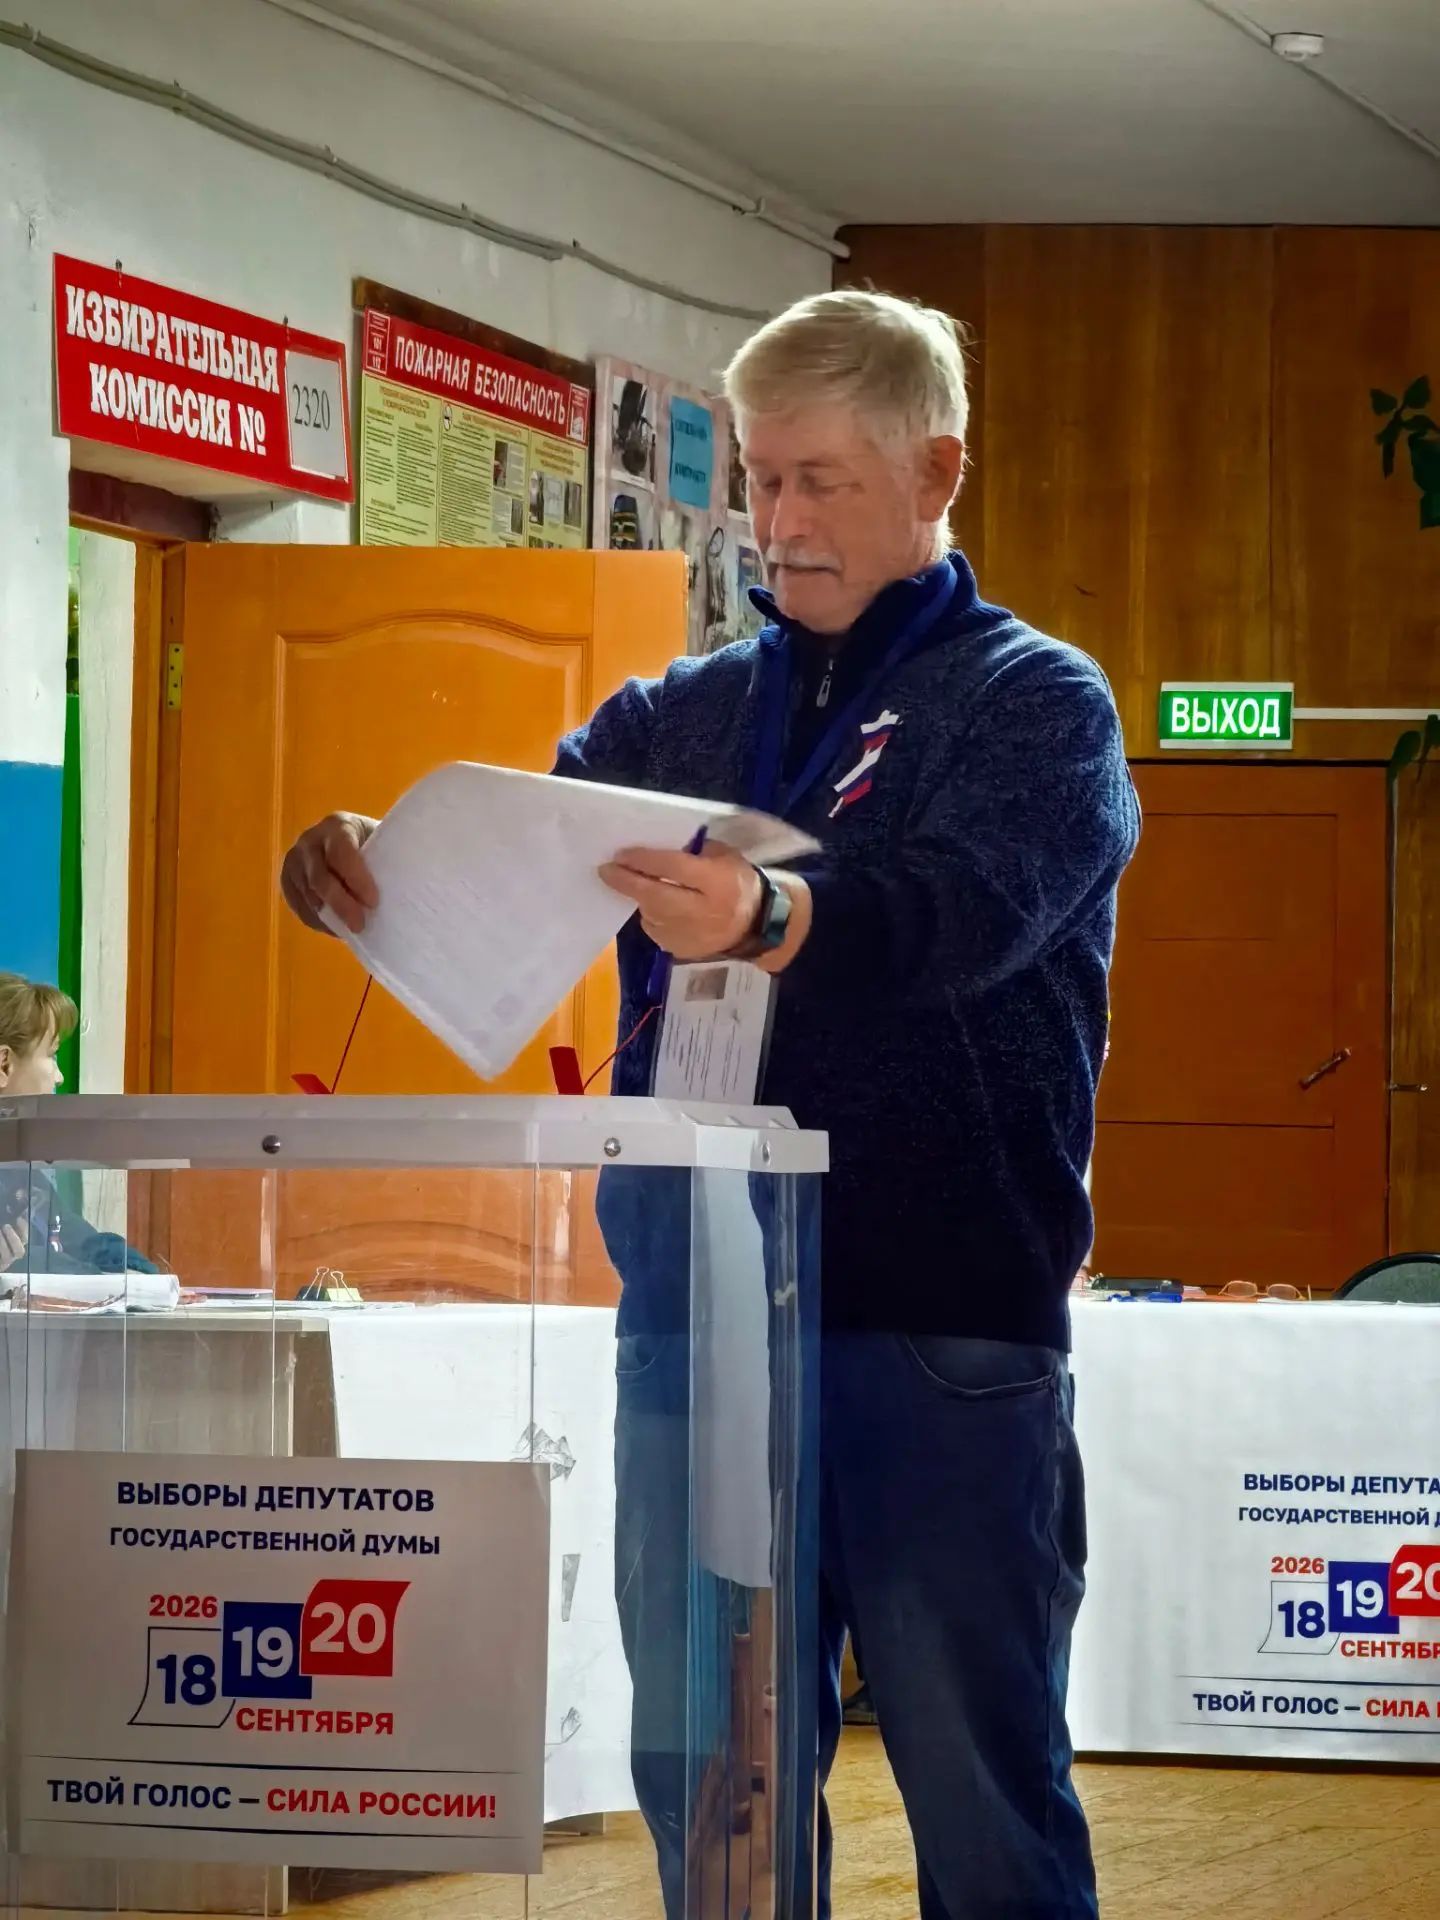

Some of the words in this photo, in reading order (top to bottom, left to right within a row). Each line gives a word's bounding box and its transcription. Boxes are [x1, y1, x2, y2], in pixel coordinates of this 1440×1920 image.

[65, 284, 281, 395] ИЗБИРАТЕЛЬНАЯ
[395, 335, 471, 392] ПОЖАРНАЯ
[474, 363, 566, 425] БЕЗОПАСНОСТЬ
[88, 362, 233, 448] КОМИССИЯ
[238, 403, 267, 456] №
[291, 384, 331, 431] 2320
[1171, 697, 1281, 737] ВЫХОД
[117, 1481, 247, 1508] ВЫБОРЫ
[255, 1485, 434, 1512] ДЕПУТАТОВ
[1244, 1474, 1345, 1493] ВЫБОРЫ
[1238, 1506, 1430, 1527] ГОСУДАРСТВЕННОЙ
[110, 1527, 355, 1553] ГОСУДАРСТВЕННОЙ
[362, 1534, 440, 1555] ДУМЫ
[1271, 1557, 1324, 1575] 2026
[149, 1594, 218, 1619] 2026
[1278, 1601, 1325, 1638] 18
[1336, 1580, 1384, 1618] 19
[156, 1654, 216, 1705] 18
[232, 1626, 294, 1678] 19
[309, 1601, 387, 1653] 20
[1193, 1691, 1256, 1713] ТВОЙ
[1262, 1696, 1339, 1716] ГОЛОС
[1366, 1698, 1430, 1718] СИЛА
[235, 1706, 395, 1736] СЕНТЯБРЯ
[47, 1776, 125, 1806] ТВОЙ
[133, 1783, 232, 1810] ГОЛОС
[266, 1787, 350, 1815] СИЛА
[357, 1790, 497, 1820] РОССИИ!
